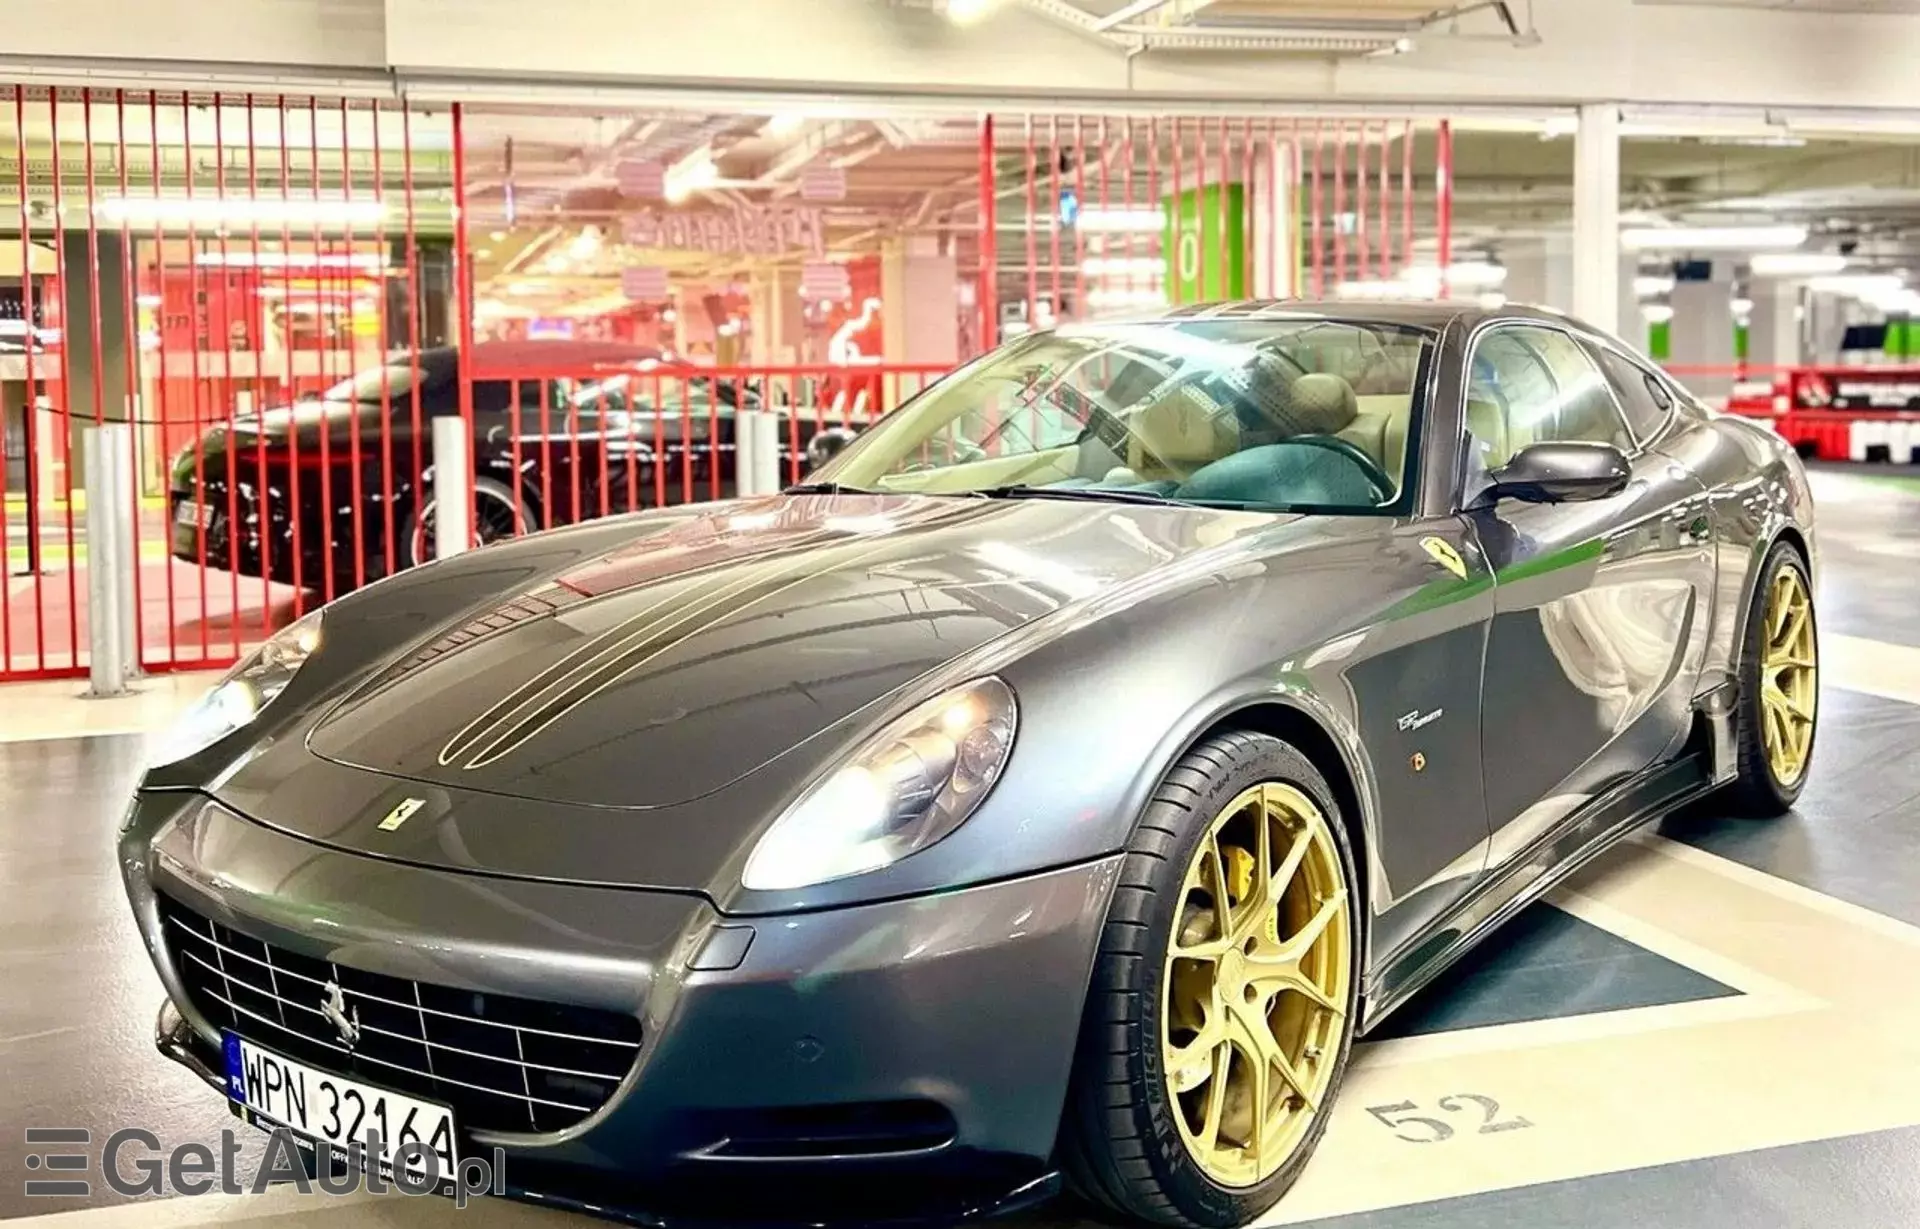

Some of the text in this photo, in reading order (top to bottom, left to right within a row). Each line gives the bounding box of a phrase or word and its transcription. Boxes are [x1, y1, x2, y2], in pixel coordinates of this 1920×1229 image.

[232, 1075, 244, 1093] PL
[244, 1047, 307, 1129] WPN
[320, 1081, 454, 1175] 32164
[1365, 1093, 1536, 1143] 52
